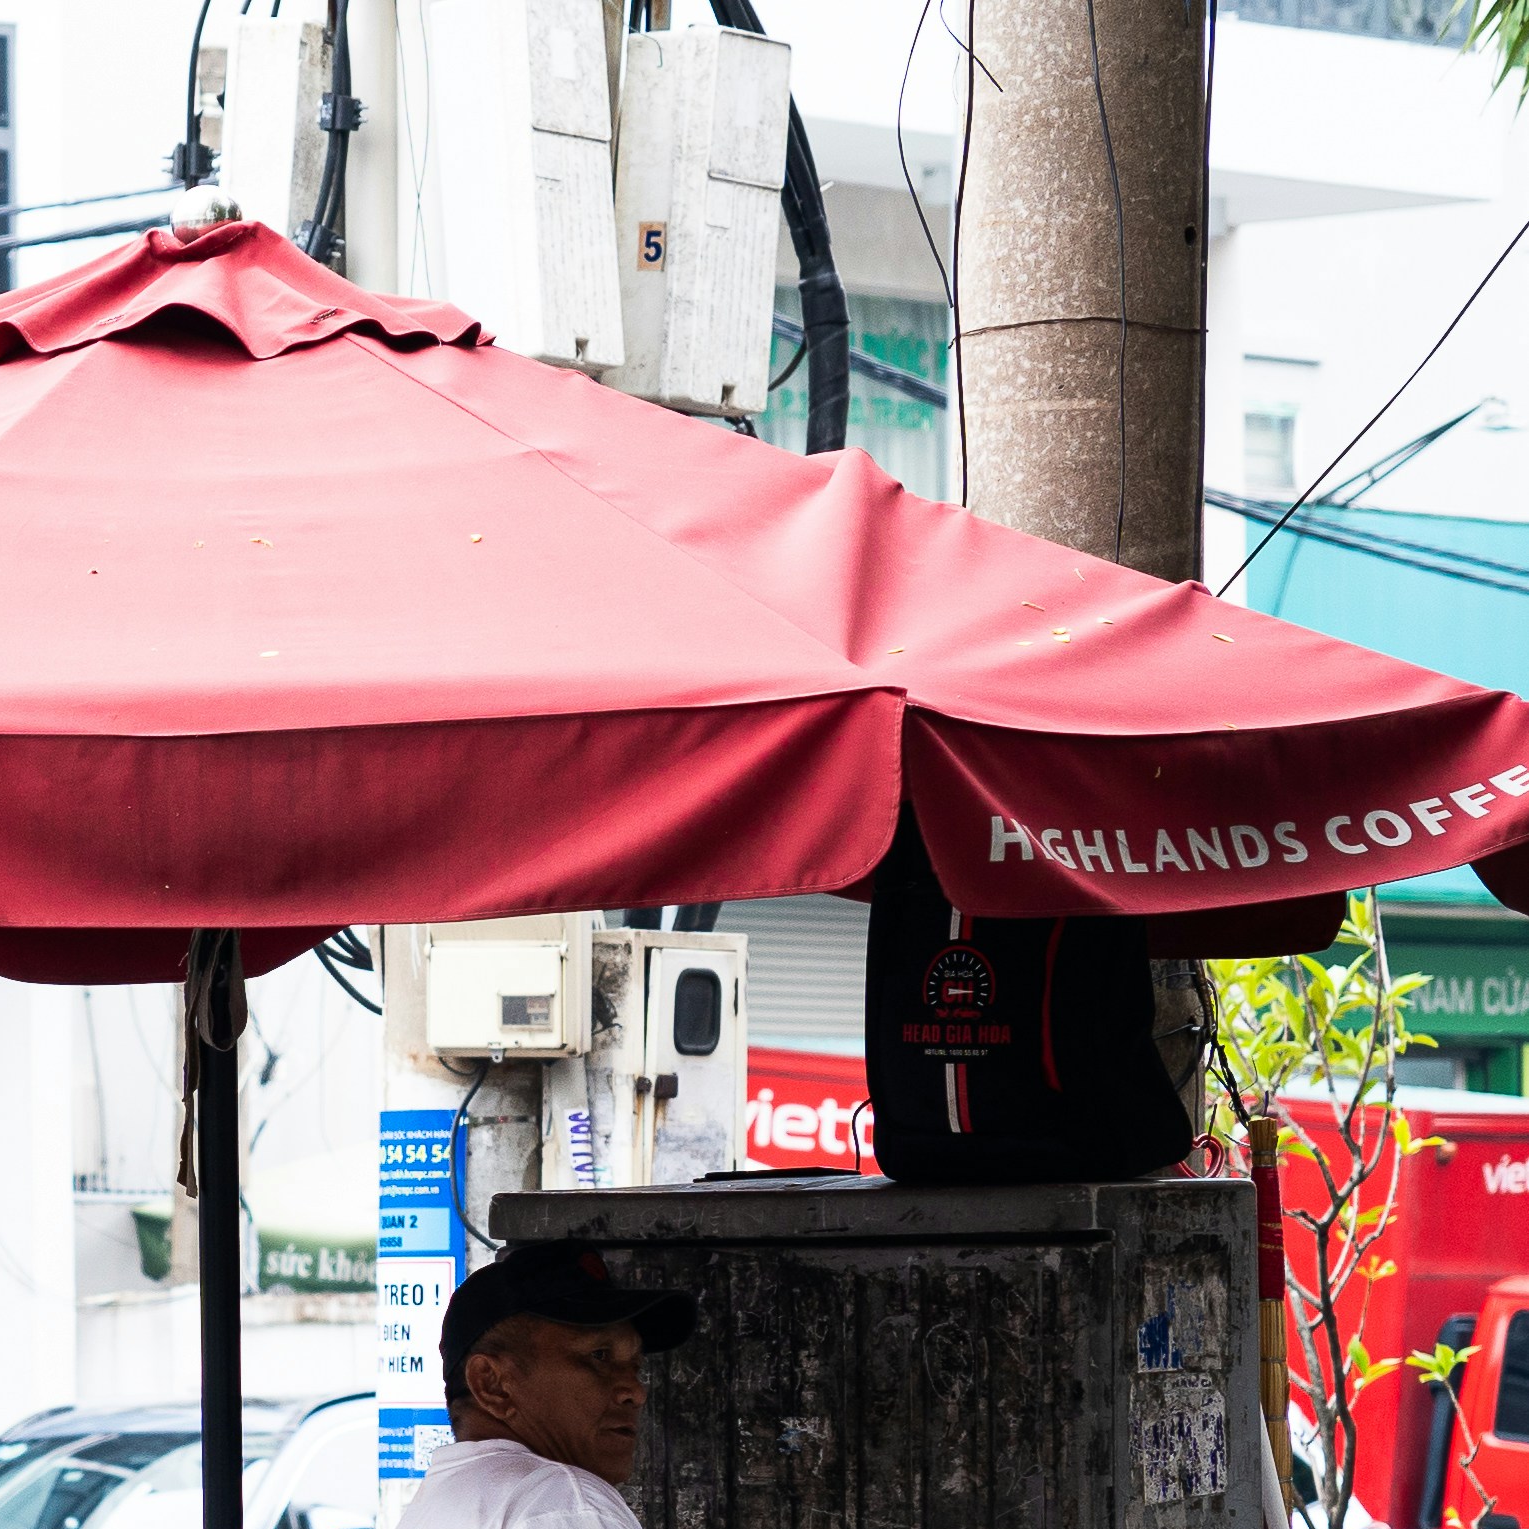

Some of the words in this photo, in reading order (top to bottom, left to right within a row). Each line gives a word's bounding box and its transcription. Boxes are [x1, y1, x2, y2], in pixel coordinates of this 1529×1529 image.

[643, 230, 663, 262] 5
[902, 1023, 942, 1044] HEAD
[945, 1023, 973, 1044] GIA
[405, 1144, 428, 1163] 54
[409, 1214, 419, 1229] 2
[265, 1242, 313, 1278] sức
